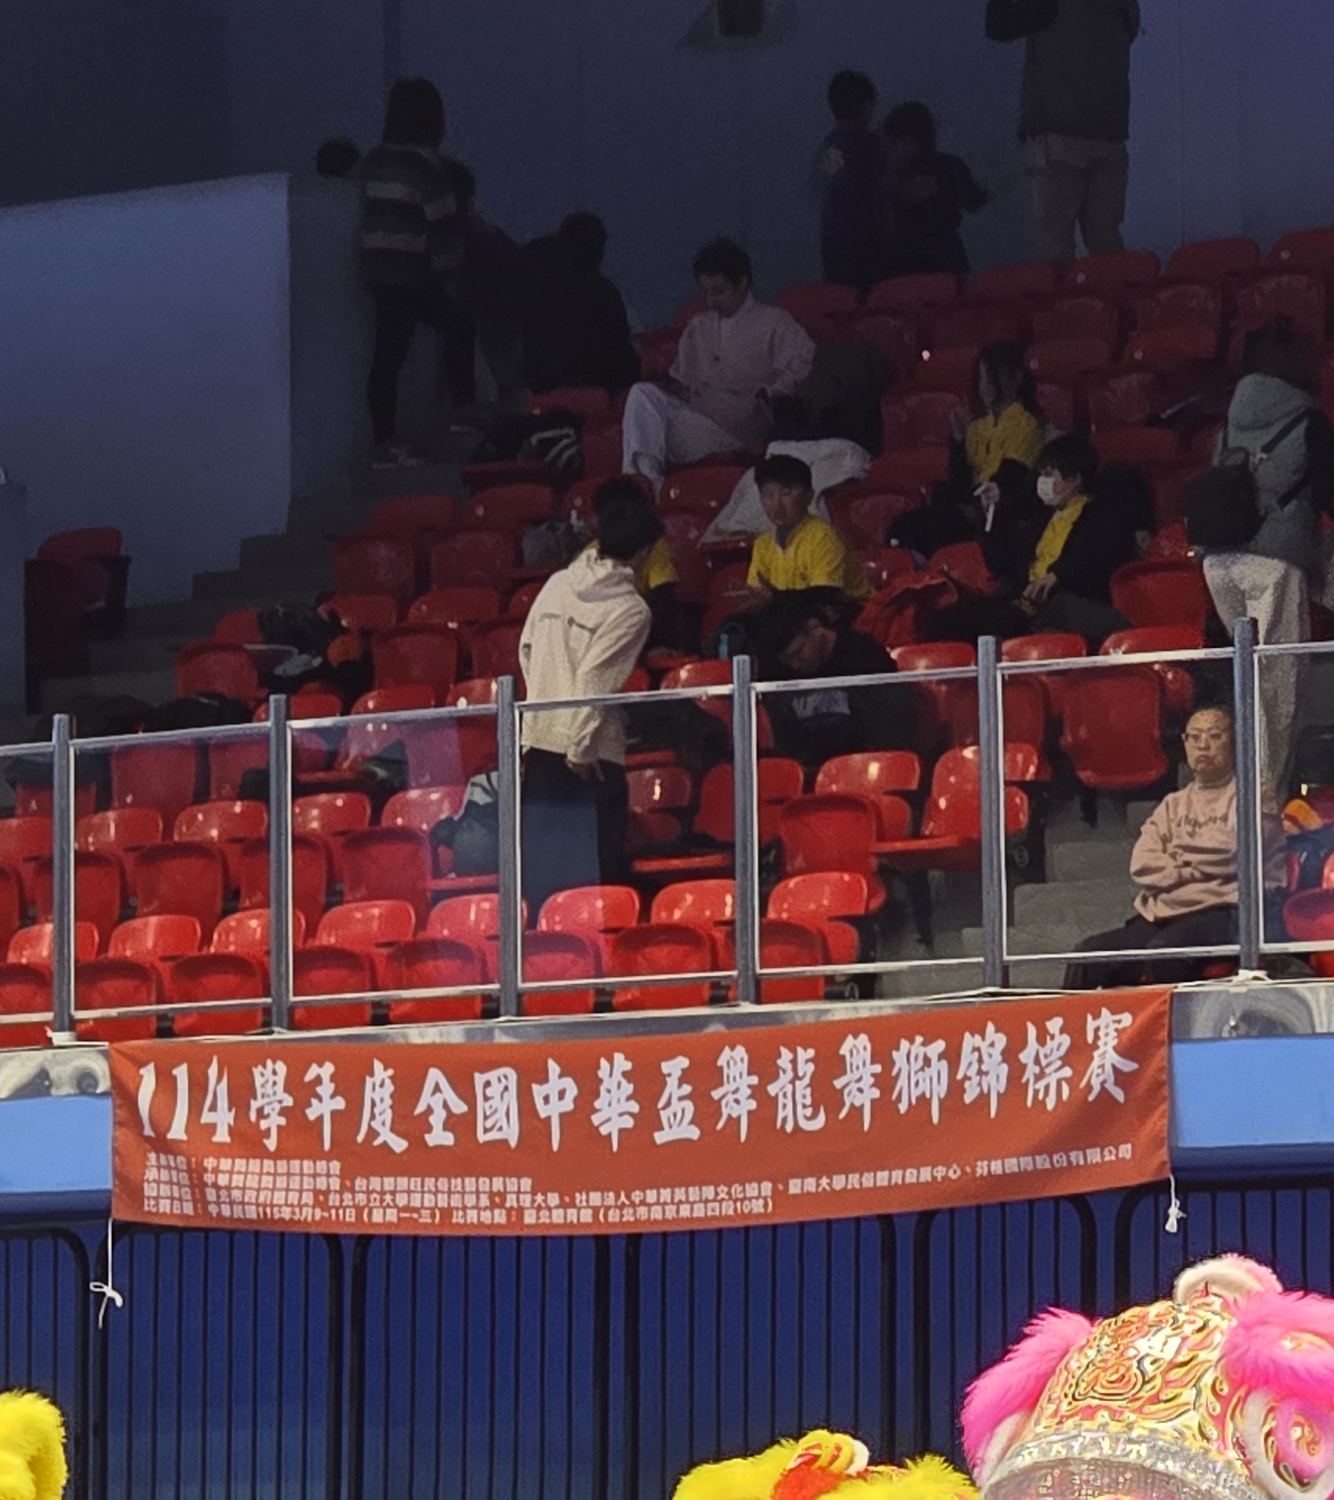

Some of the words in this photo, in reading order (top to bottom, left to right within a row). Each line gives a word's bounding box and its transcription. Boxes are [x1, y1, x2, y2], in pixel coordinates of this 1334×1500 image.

[137, 1007, 1139, 1153] 114學年度全國中華盃舞龍舞獅錦標賽
